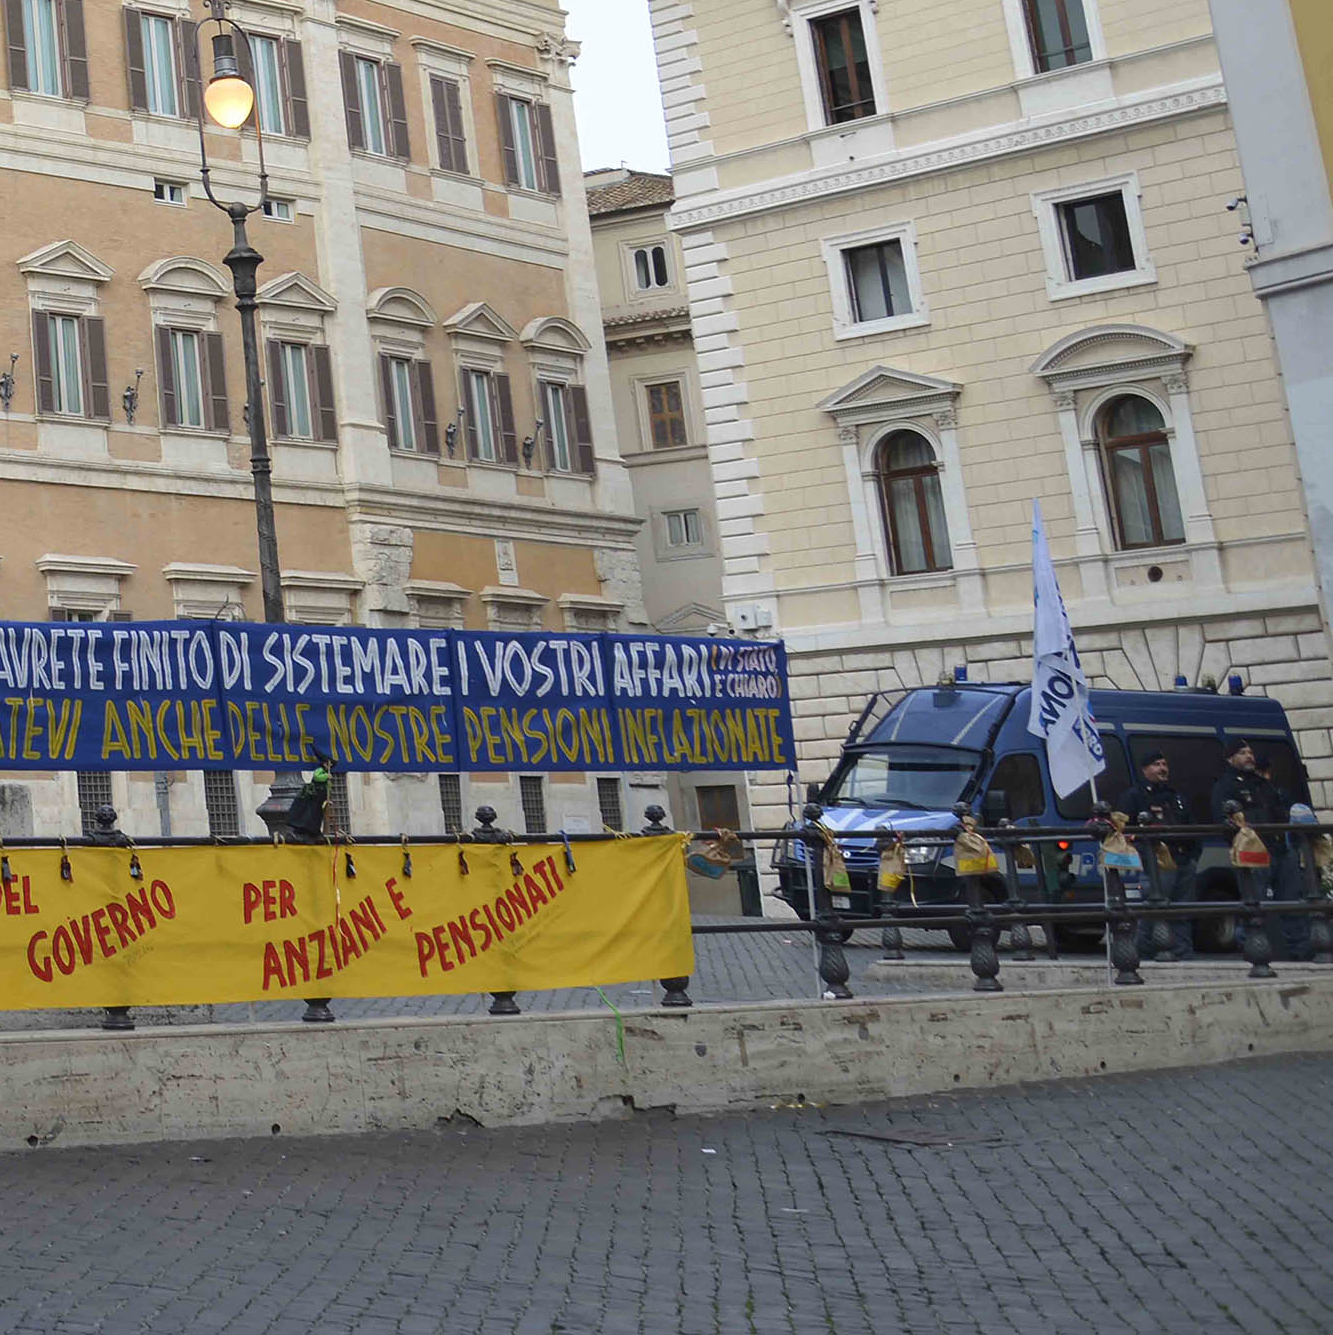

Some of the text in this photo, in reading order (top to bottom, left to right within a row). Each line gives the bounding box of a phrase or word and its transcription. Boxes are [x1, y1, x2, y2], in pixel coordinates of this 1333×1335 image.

[113, 629, 213, 692] FINITO
[219, 631, 250, 692] DI
[262, 631, 452, 697] SISTEMARE
[457, 639, 469, 696] I
[473, 639, 605, 698] VOSTRI
[613, 641, 711, 699] AFFARI
[101, 698, 224, 761] ANCHE
[228, 700, 314, 762] DELLE
[326, 703, 454, 763] NOSTRE
[463, 706, 614, 764] PENSIONI
[617, 707, 787, 765] INFLAZIONATE
[28, 879, 176, 982] GOVERNO
[243, 879, 297, 925] PER
[262, 877, 414, 992] ANZIANI E
[415, 855, 564, 978] PENSIONATI
